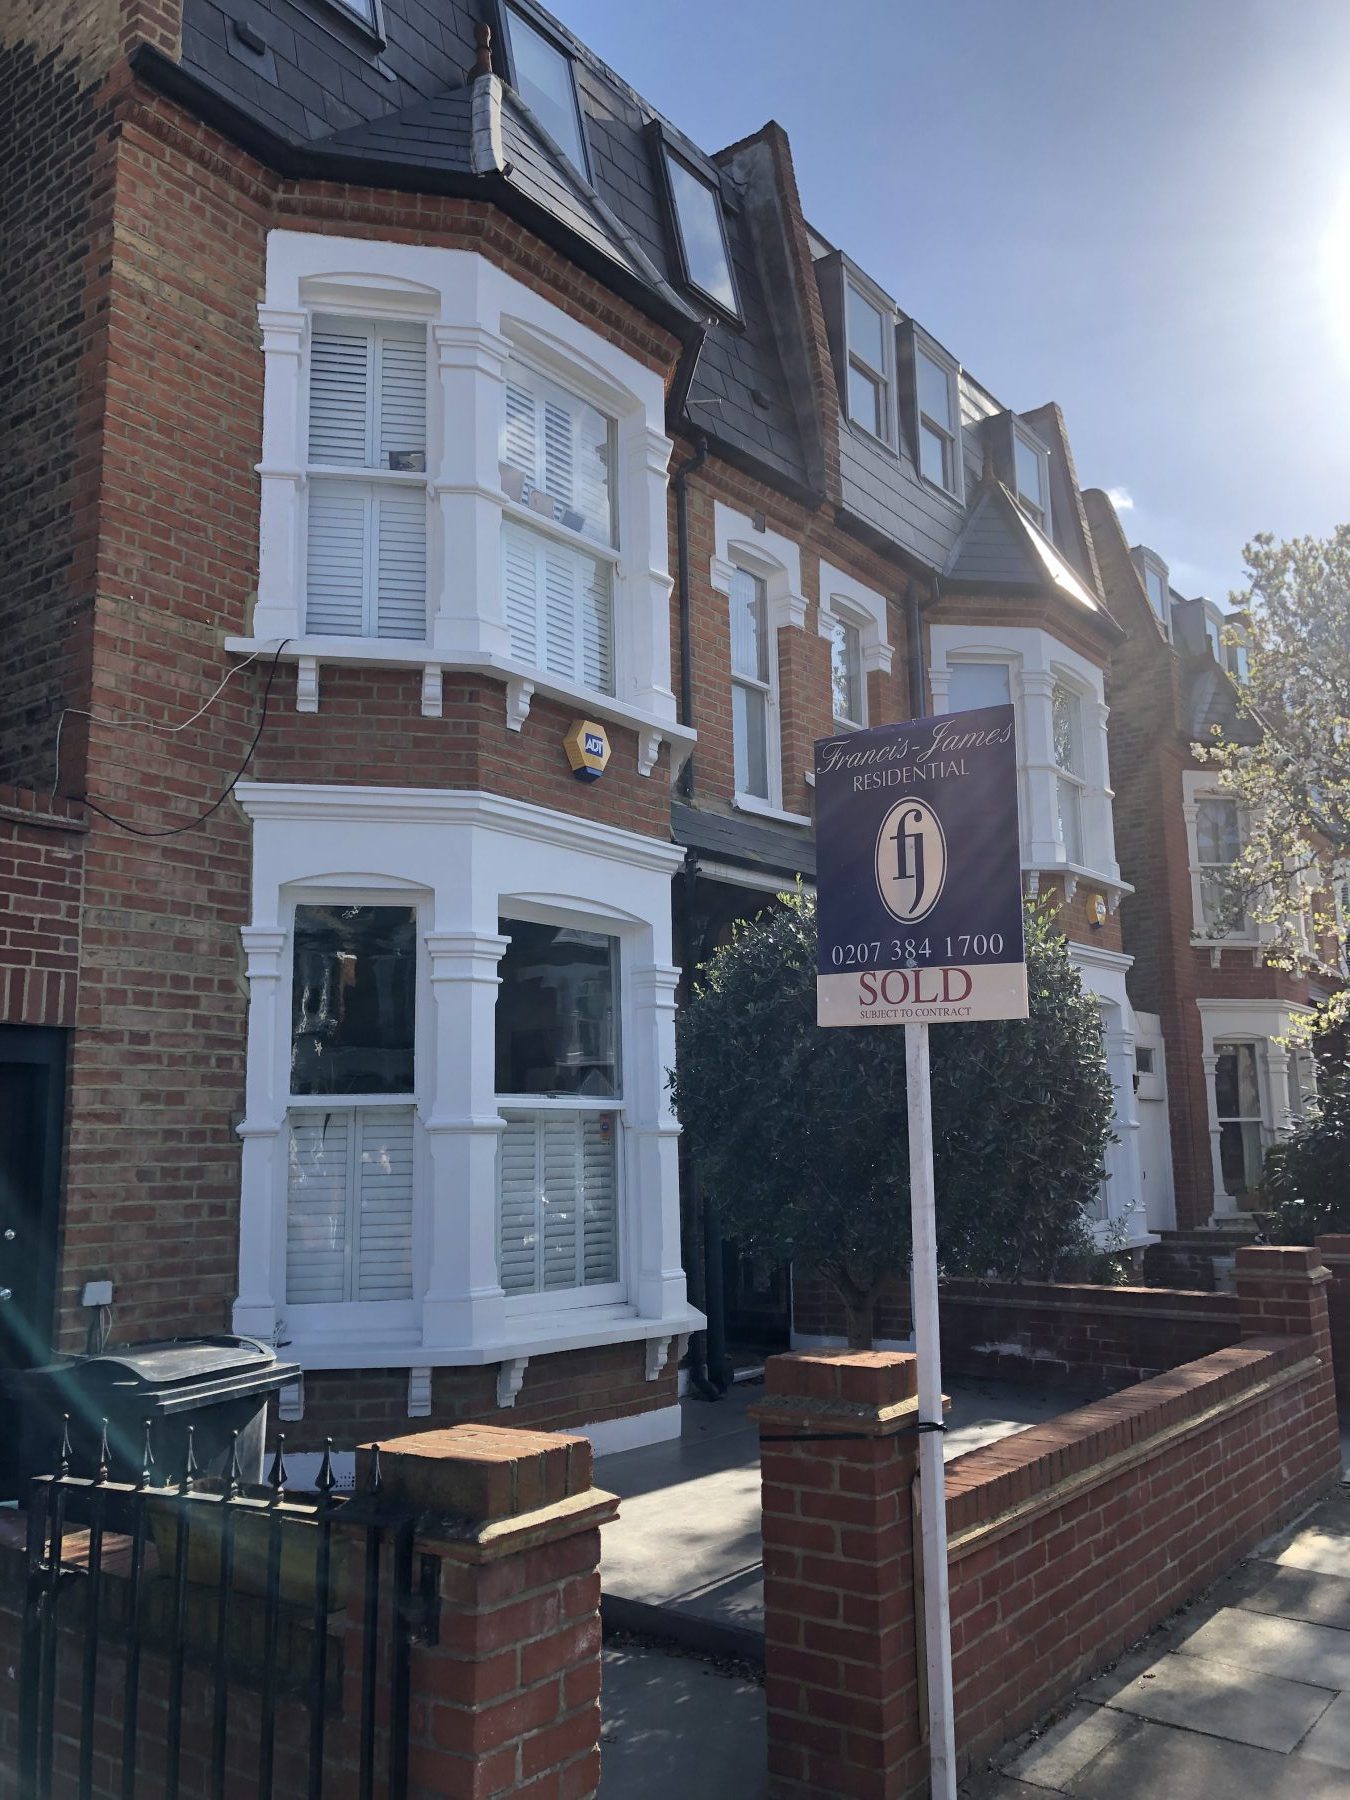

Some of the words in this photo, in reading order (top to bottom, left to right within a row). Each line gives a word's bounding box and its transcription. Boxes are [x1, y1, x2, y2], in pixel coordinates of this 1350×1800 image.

[585, 738, 604, 754] ADT
[853, 759, 970, 792] RESIDENTIAL
[831, 942, 880, 965] 0207
[890, 938, 932, 961] 384
[946, 933, 1004, 957] 1700
[858, 967, 973, 1006] SOLD
[860, 1009, 898, 1019] SUBJECT
[899, 1008, 914, 1018] TO
[915, 1007, 972, 1018] CONTRACT
